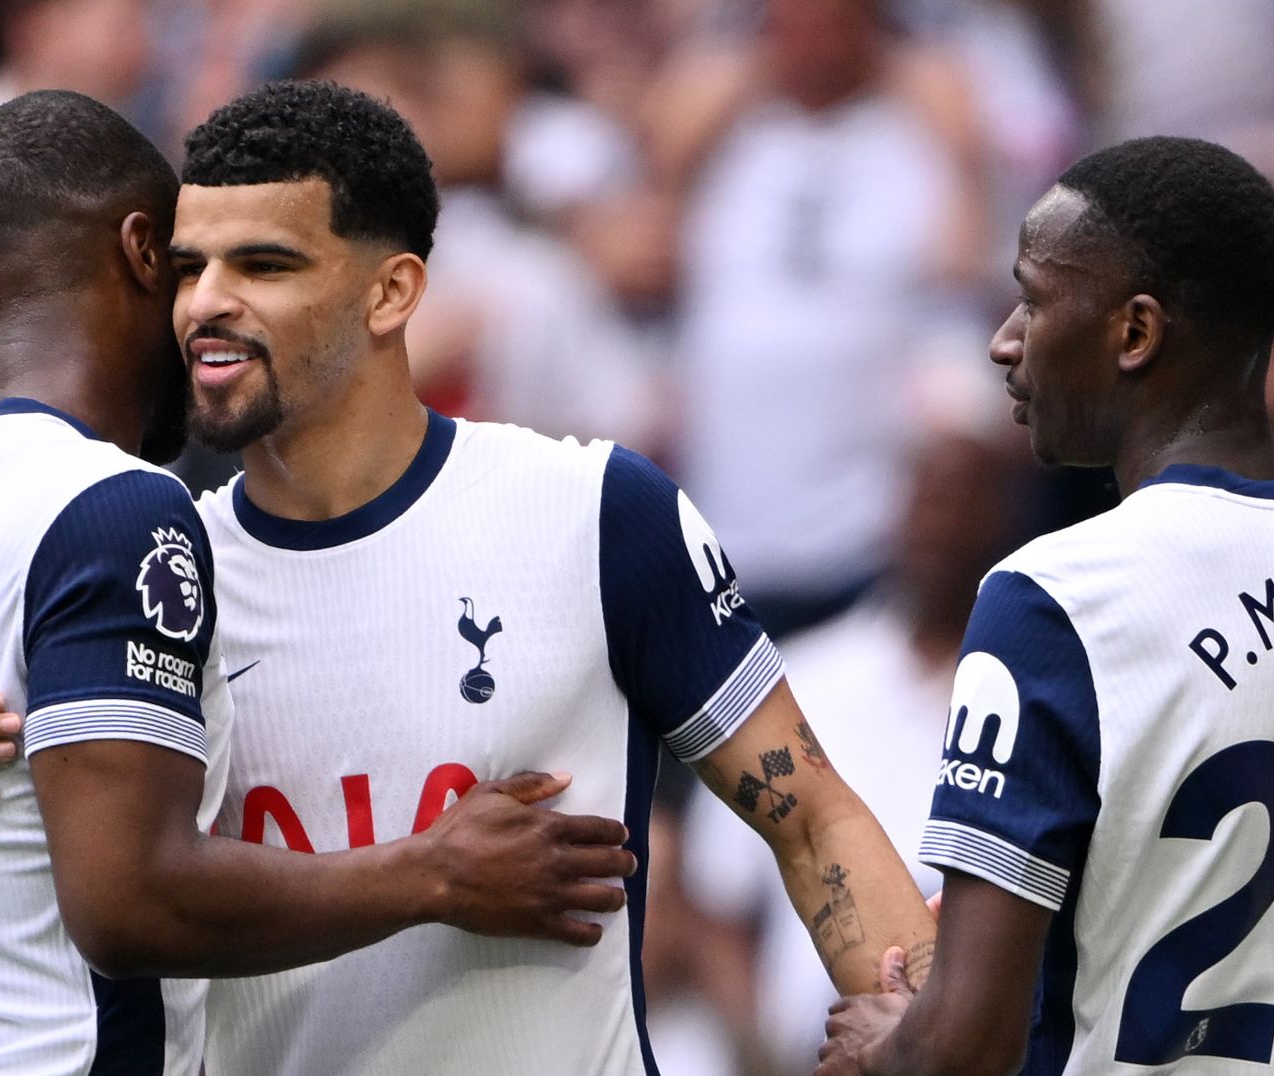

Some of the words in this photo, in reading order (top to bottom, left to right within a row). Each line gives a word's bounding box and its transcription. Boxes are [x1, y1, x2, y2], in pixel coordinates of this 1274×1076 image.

[126, 640, 156, 665] No
[157, 651, 196, 679] room
[126, 658, 154, 682] for
[155, 669, 196, 698] racism
